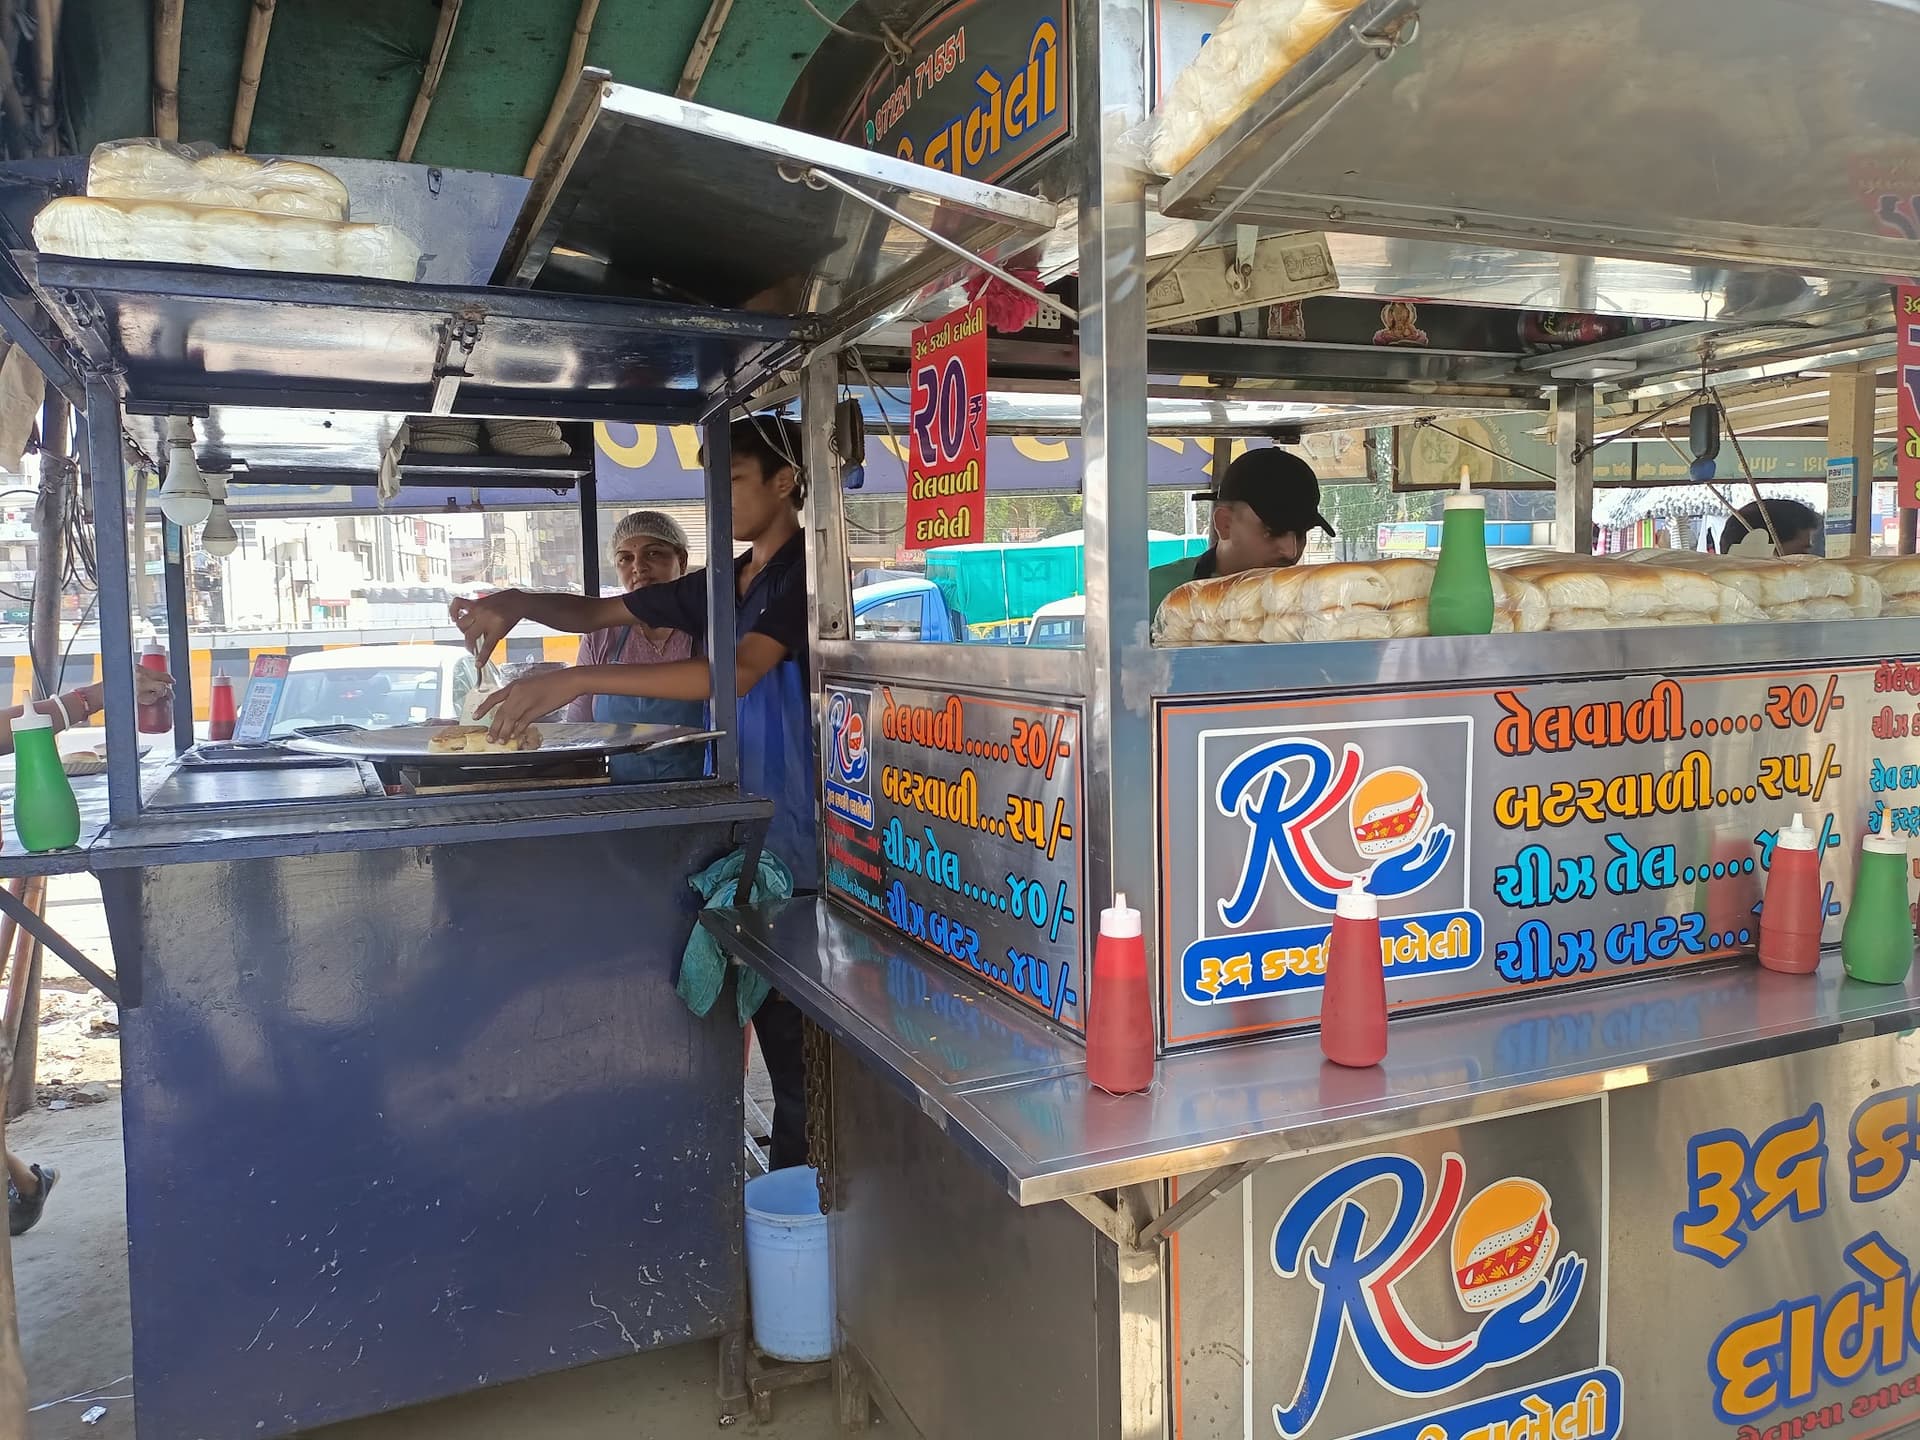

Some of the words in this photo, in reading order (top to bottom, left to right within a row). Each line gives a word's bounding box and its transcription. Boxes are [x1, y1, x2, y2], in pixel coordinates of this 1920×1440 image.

[875, 75, 911, 141] 97221
[915, 26, 967, 97] 71551
[911, 458, 980, 501] તેલવાળી
[915, 506, 971, 541] દાબેલી
[883, 817, 926, 876] ચીઝ
[1494, 844, 1598, 909] ચીઝ
[886, 880, 926, 940] ચીઝ
[1382, 917, 1472, 966] ાબેલી
[1494, 918, 1598, 984] ચીઝ
[1673, 1102, 1829, 1269] રૂદ્ર
[1708, 1230, 1920, 1425] દાબે
